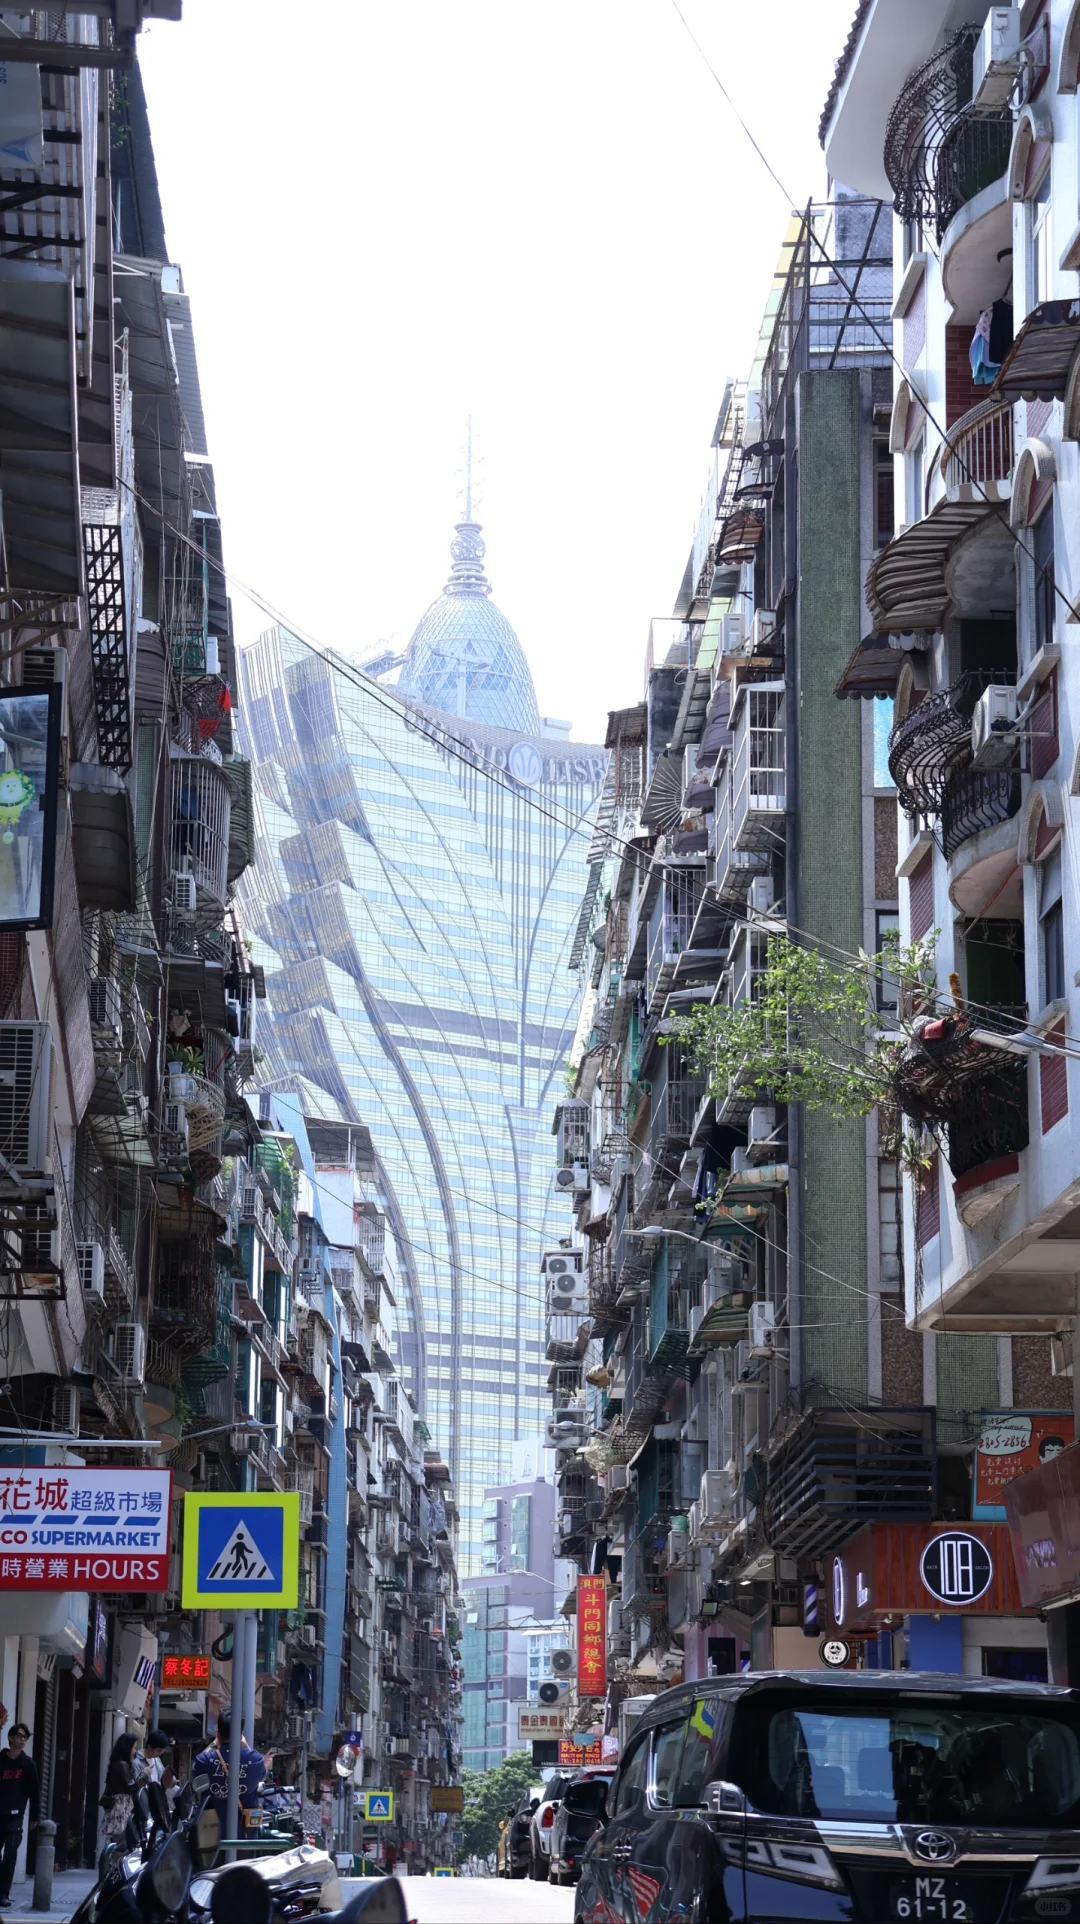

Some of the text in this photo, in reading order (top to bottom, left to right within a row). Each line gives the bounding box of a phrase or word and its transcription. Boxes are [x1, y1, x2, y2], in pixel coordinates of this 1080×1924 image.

[545, 757, 608, 784] LISB
[0, 1477, 162, 1513] 花城 超級市場
[0, 1530, 161, 1547] CO SUPERMARKET
[1, 1558, 159, 1580] 時營業 HOURS
[580, 1579, 605, 1589] 澳門
[583, 1593, 602, 1674] 斗門同鄉總會
[165, 1657, 209, 1677] 蔡冬記
[915, 1877, 946, 1898] MZ
[897, 1897, 967, 1920] 61-12
